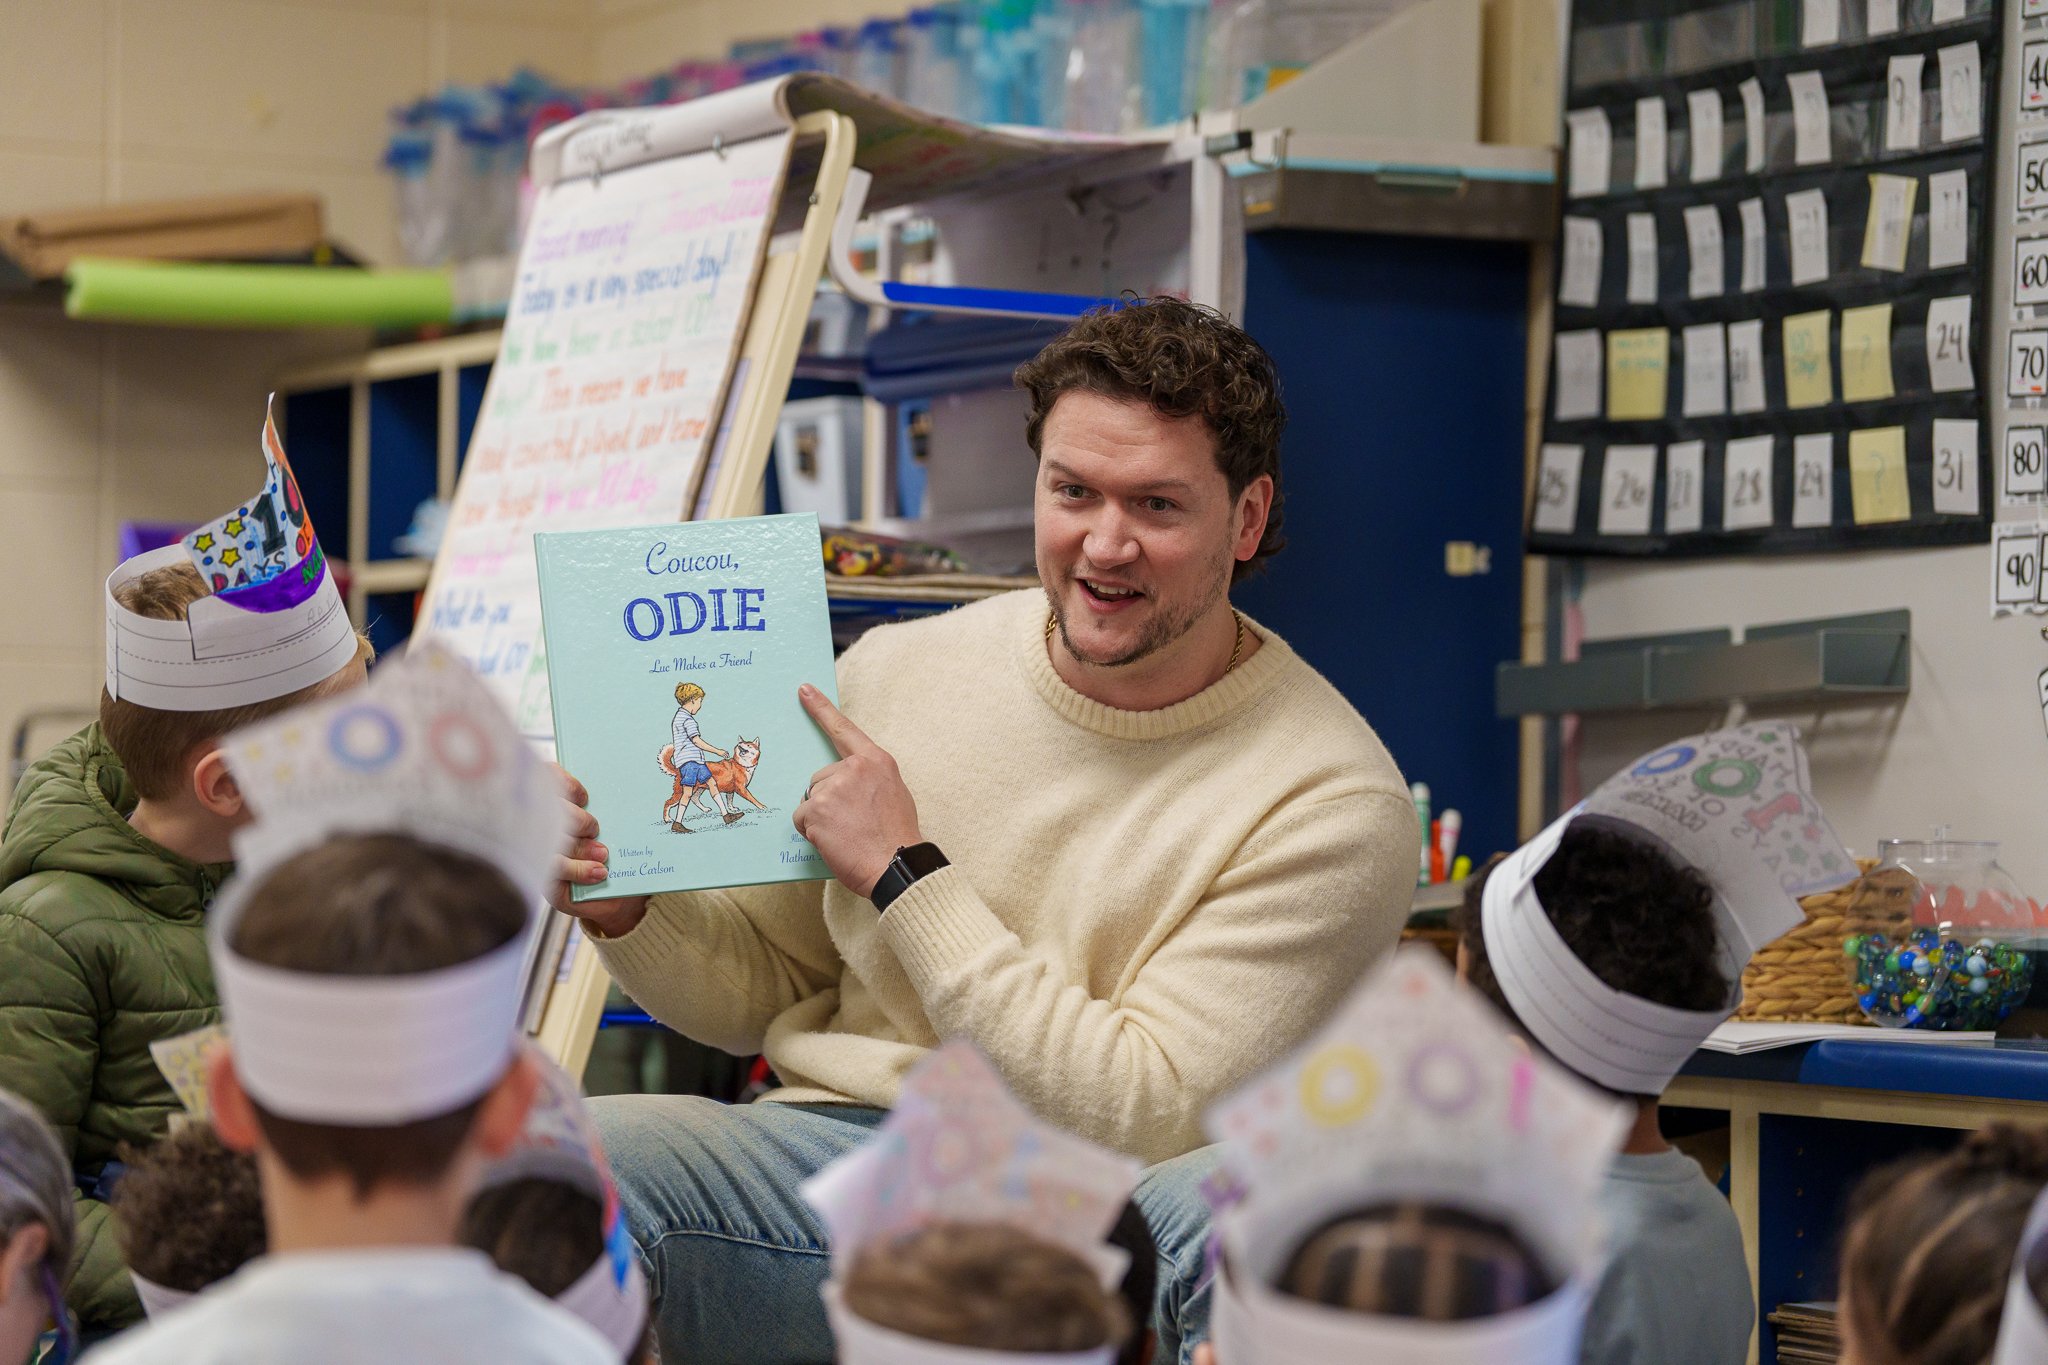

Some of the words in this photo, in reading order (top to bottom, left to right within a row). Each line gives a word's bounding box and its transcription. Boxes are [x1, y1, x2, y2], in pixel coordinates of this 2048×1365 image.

[2030, 55, 2048, 90] 4
[2022, 253, 2048, 288] 60
[1936, 321, 1964, 362] 24
[2017, 345, 2045, 380] 70
[1937, 447, 1964, 491] 31
[2013, 441, 2041, 477] 80
[1733, 467, 1762, 508] 28
[1799, 460, 1825, 499] 29
[211, 550, 287, 594] DAYS
[645, 541, 739, 576] Coucou,
[2007, 551, 2034, 588] 90
[623, 588, 766, 641] ODIE
[649, 658, 670, 673] Luc
[673, 655, 707, 671] Makes
[709, 660, 716, 669] a
[719, 650, 753, 668] Friend
[618, 848, 644, 858] Written
[645, 845, 654, 858] by
[639, 860, 675, 876] Carlson
[779, 849, 816, 864] Nathan
